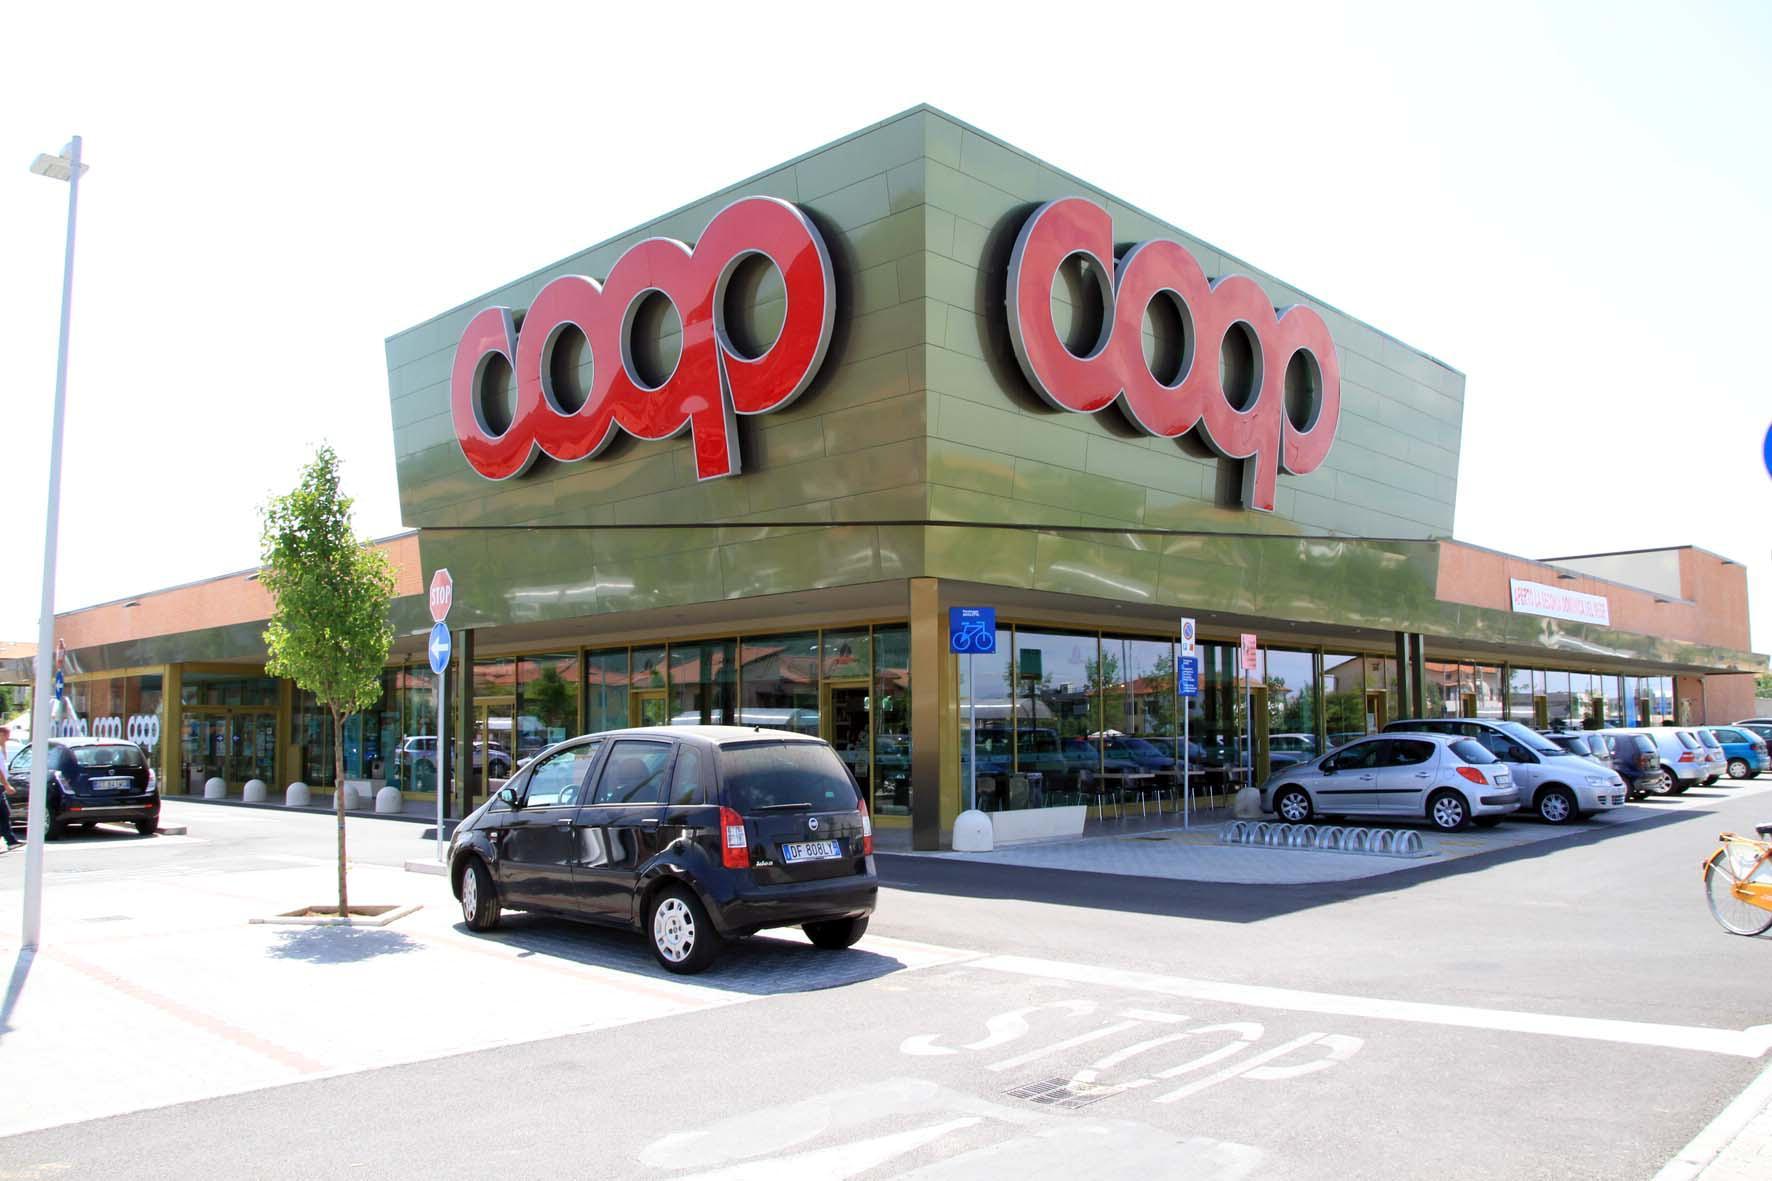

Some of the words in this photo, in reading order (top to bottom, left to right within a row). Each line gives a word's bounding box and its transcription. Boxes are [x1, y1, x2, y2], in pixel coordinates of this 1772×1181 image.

[450, 195, 837, 482] coop
[1006, 196, 1341, 513] coop
[431, 585, 450, 606] STOP
[127, 714, 160, 753] coop
[900, 999, 1364, 1104] STOP
